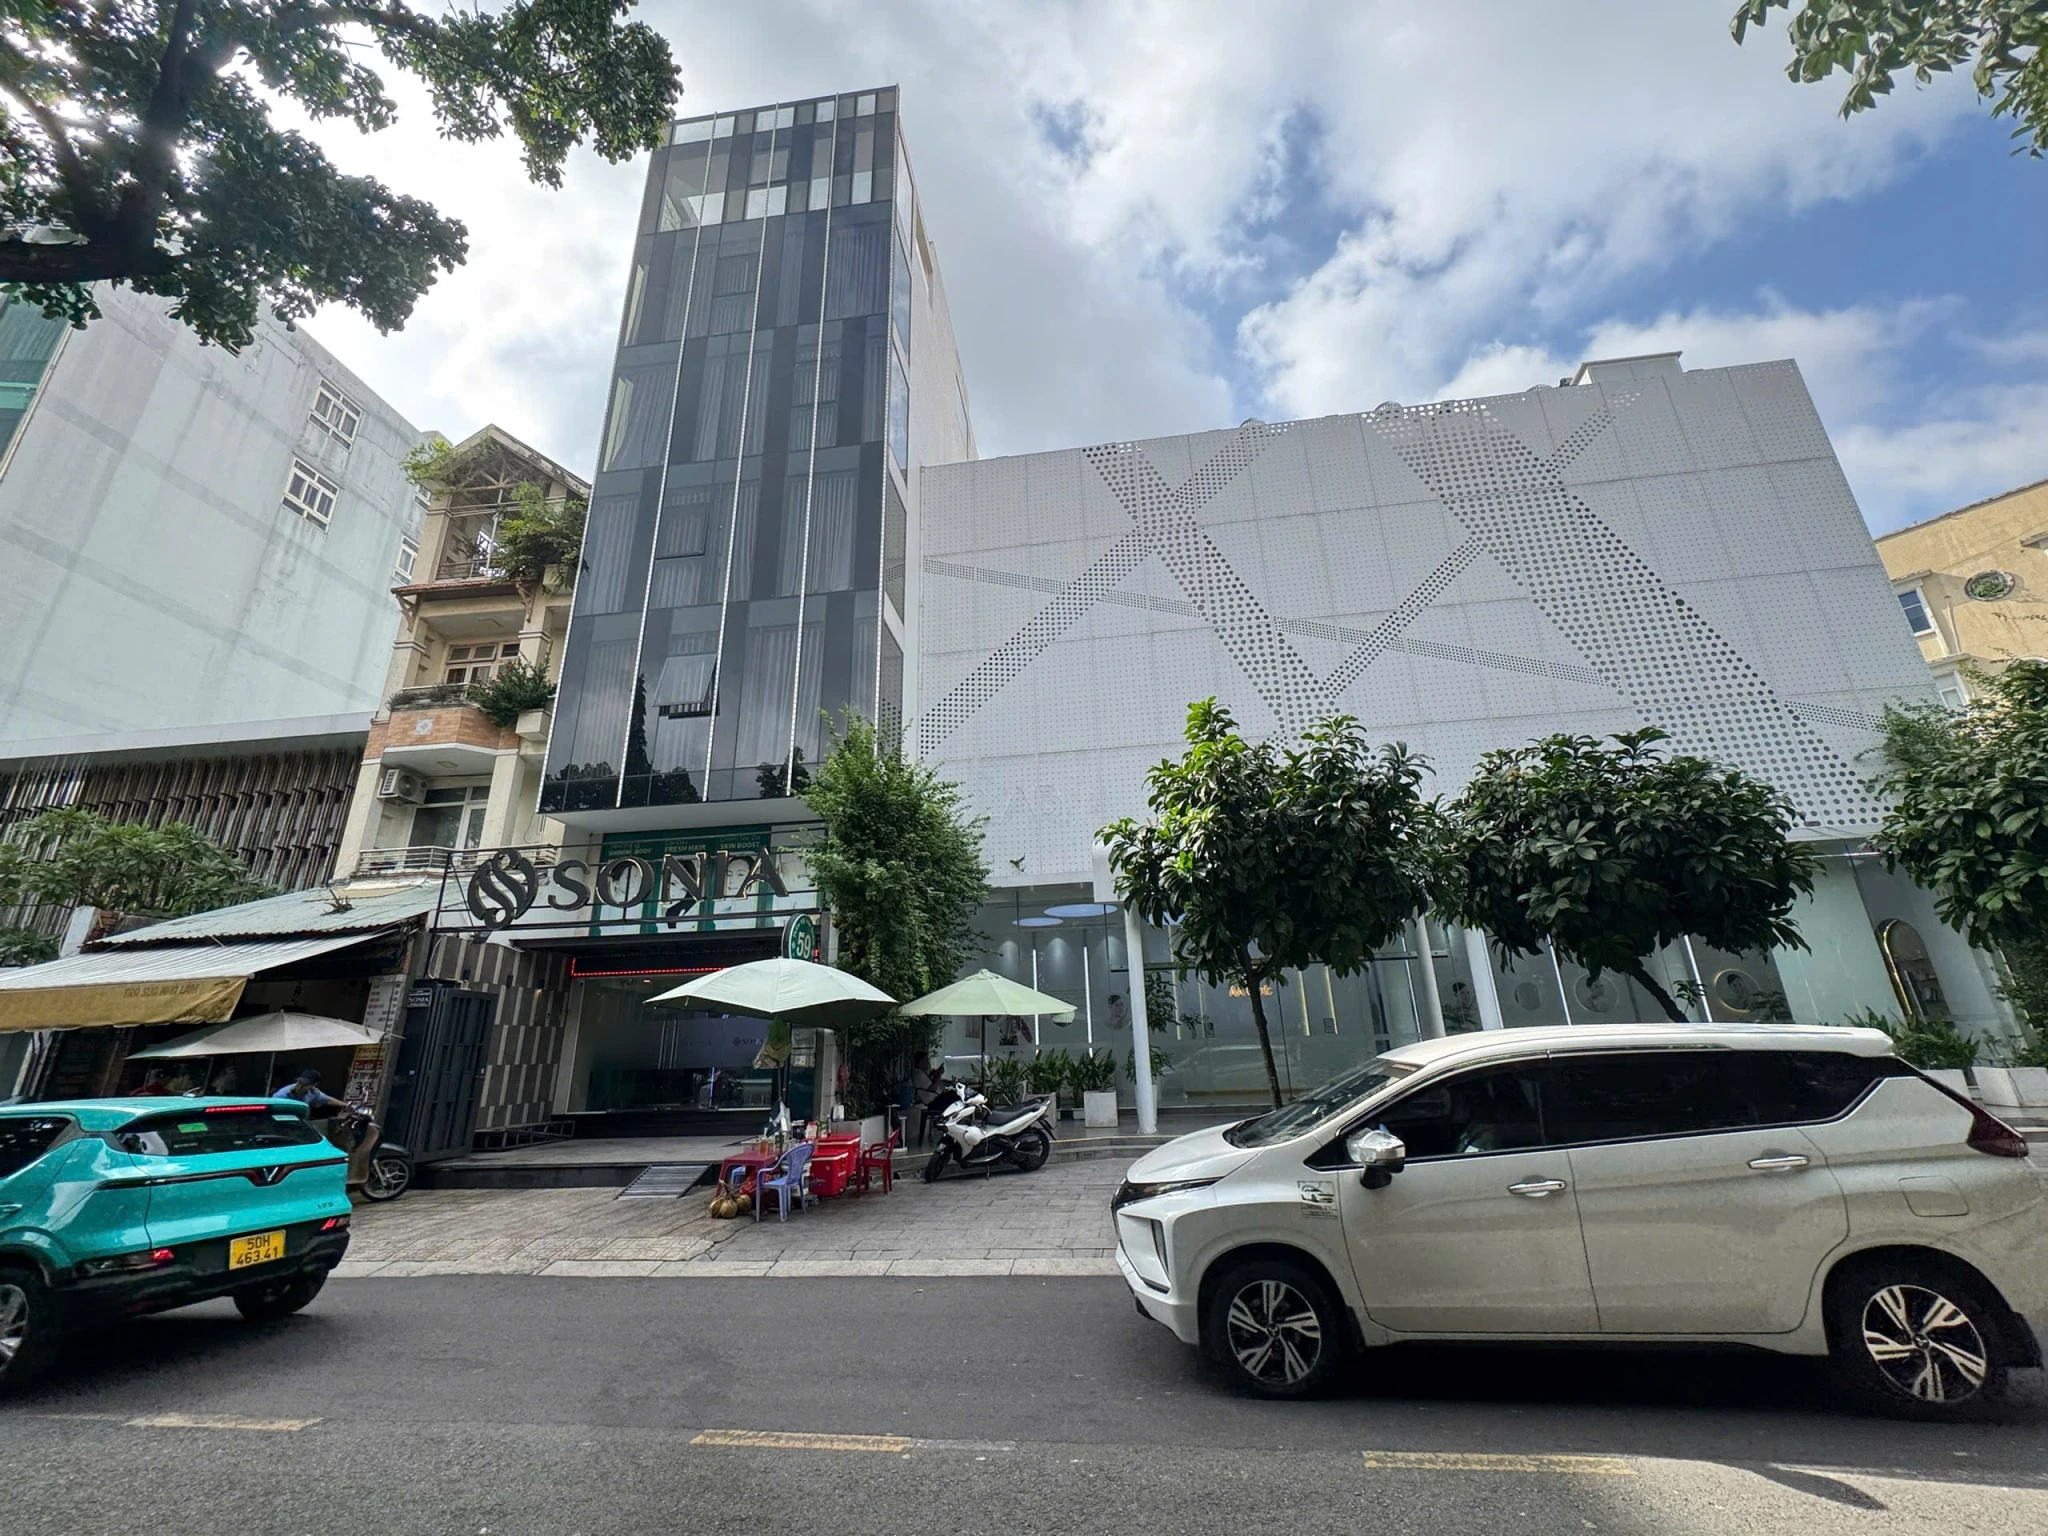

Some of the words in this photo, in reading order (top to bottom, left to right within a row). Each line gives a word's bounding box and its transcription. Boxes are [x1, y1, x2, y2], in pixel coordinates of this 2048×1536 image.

[664, 845, 688, 853] FRESH
[688, 844, 707, 852] HAIR
[547, 847, 789, 911] SONIA
[796, 931, 811, 960] 59
[247, 1235, 270, 1251] 50H
[236, 1246, 278, 1266] 463.41
